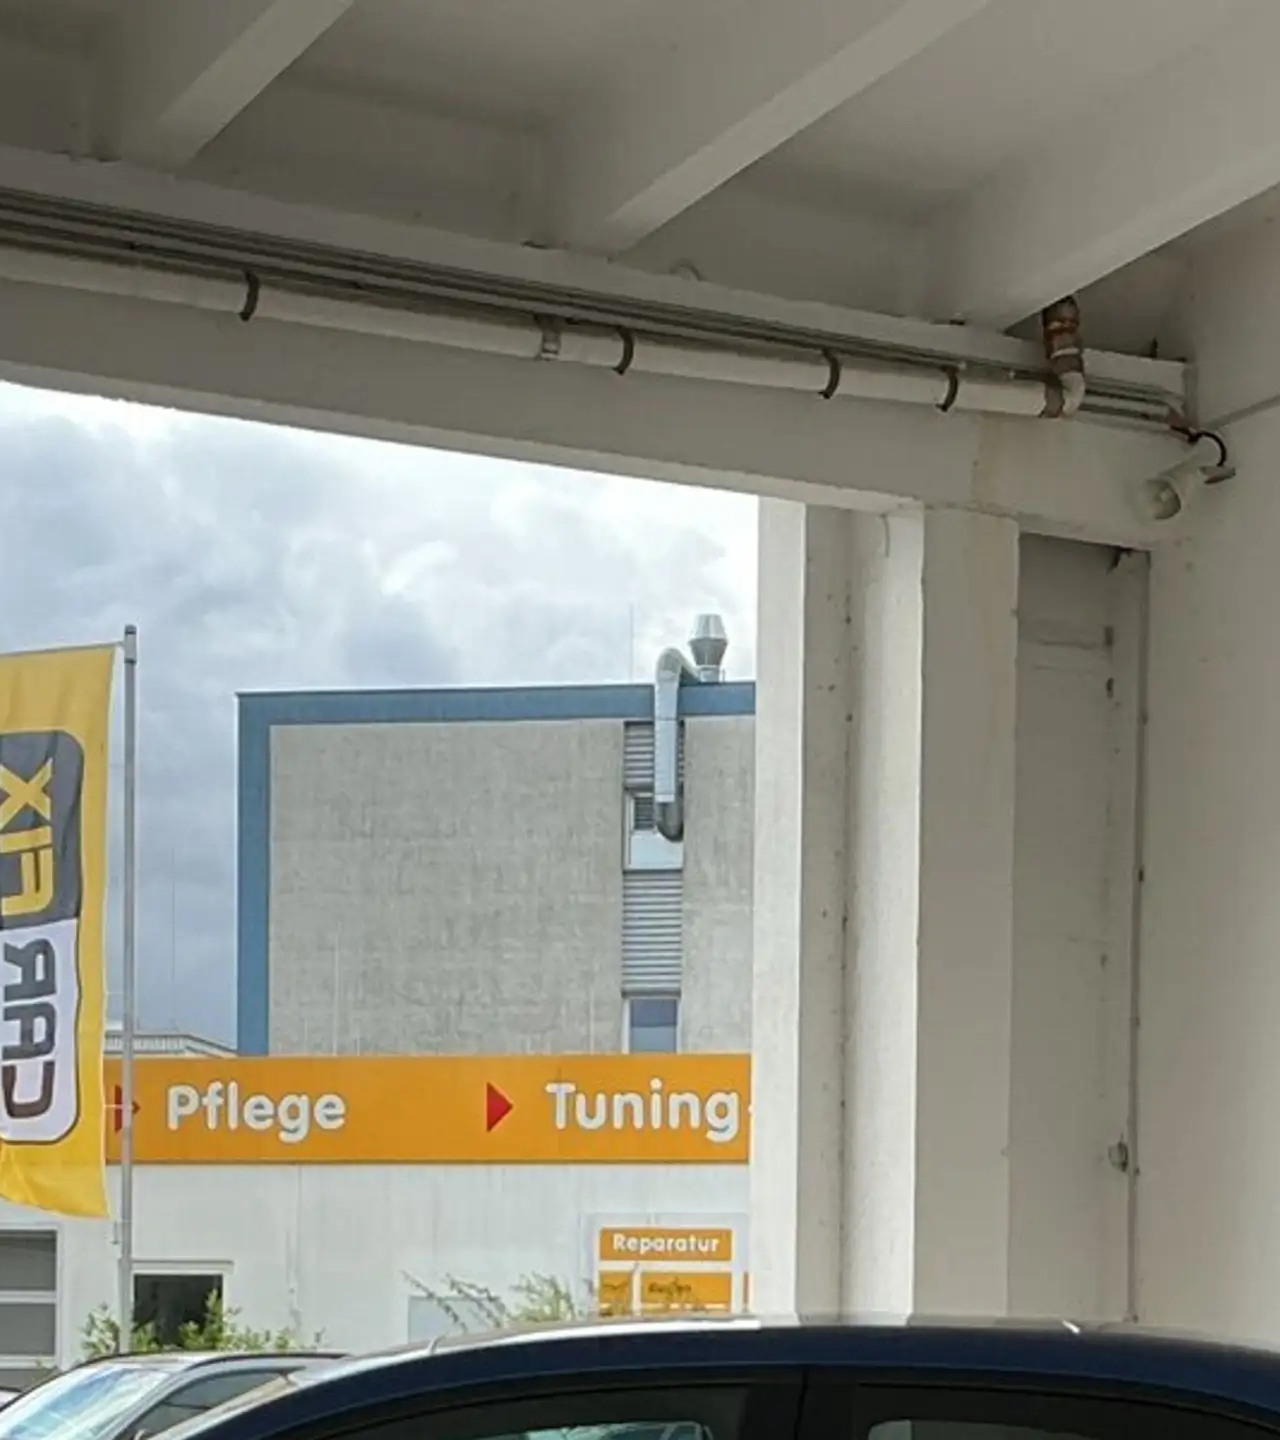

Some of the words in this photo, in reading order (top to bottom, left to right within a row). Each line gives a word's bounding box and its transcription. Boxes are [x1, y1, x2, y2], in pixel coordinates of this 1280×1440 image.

[168, 1081, 346, 1143] Pflege
[545, 1078, 739, 1143] Tuning
[613, 1233, 720, 1255] Reparatur
